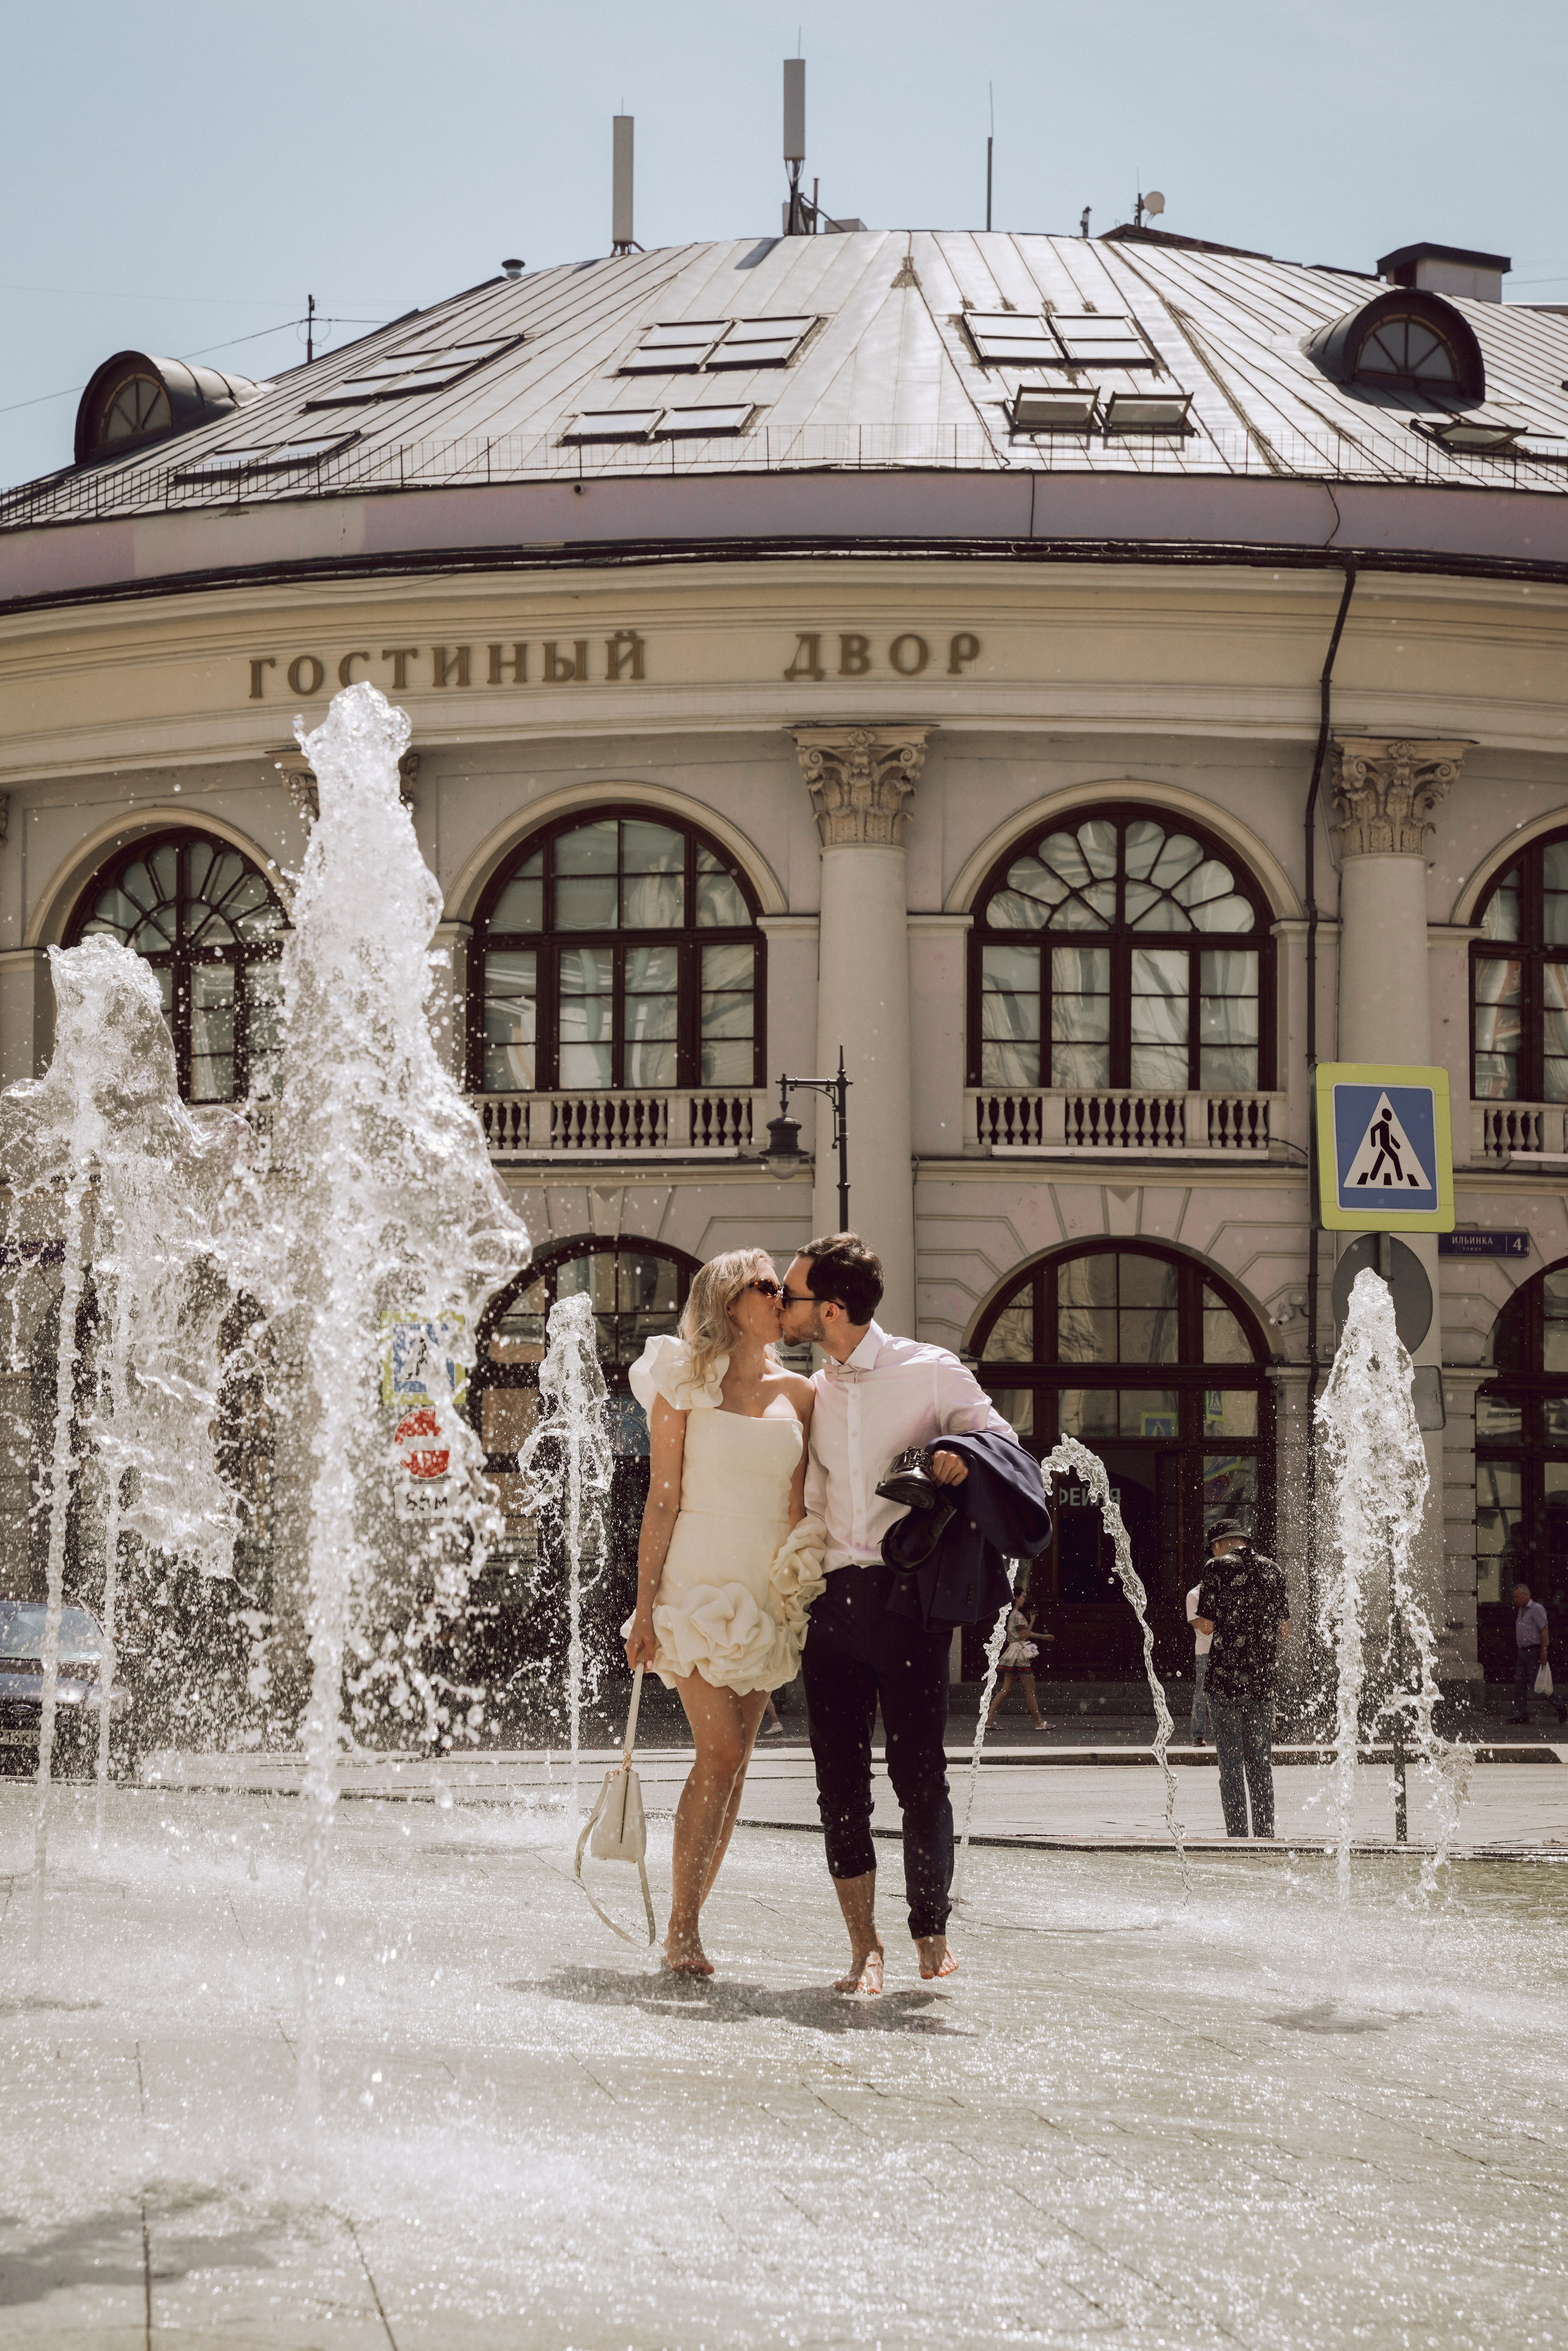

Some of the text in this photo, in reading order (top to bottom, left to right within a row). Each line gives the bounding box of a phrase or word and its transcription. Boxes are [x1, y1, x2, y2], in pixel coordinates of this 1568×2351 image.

[249, 630, 979, 698] ГОСТИНЫЙ ДВОР
[1452, 1236, 1493, 1245] ИЛЬИНКА
[1513, 1237, 1522, 1251] 4
